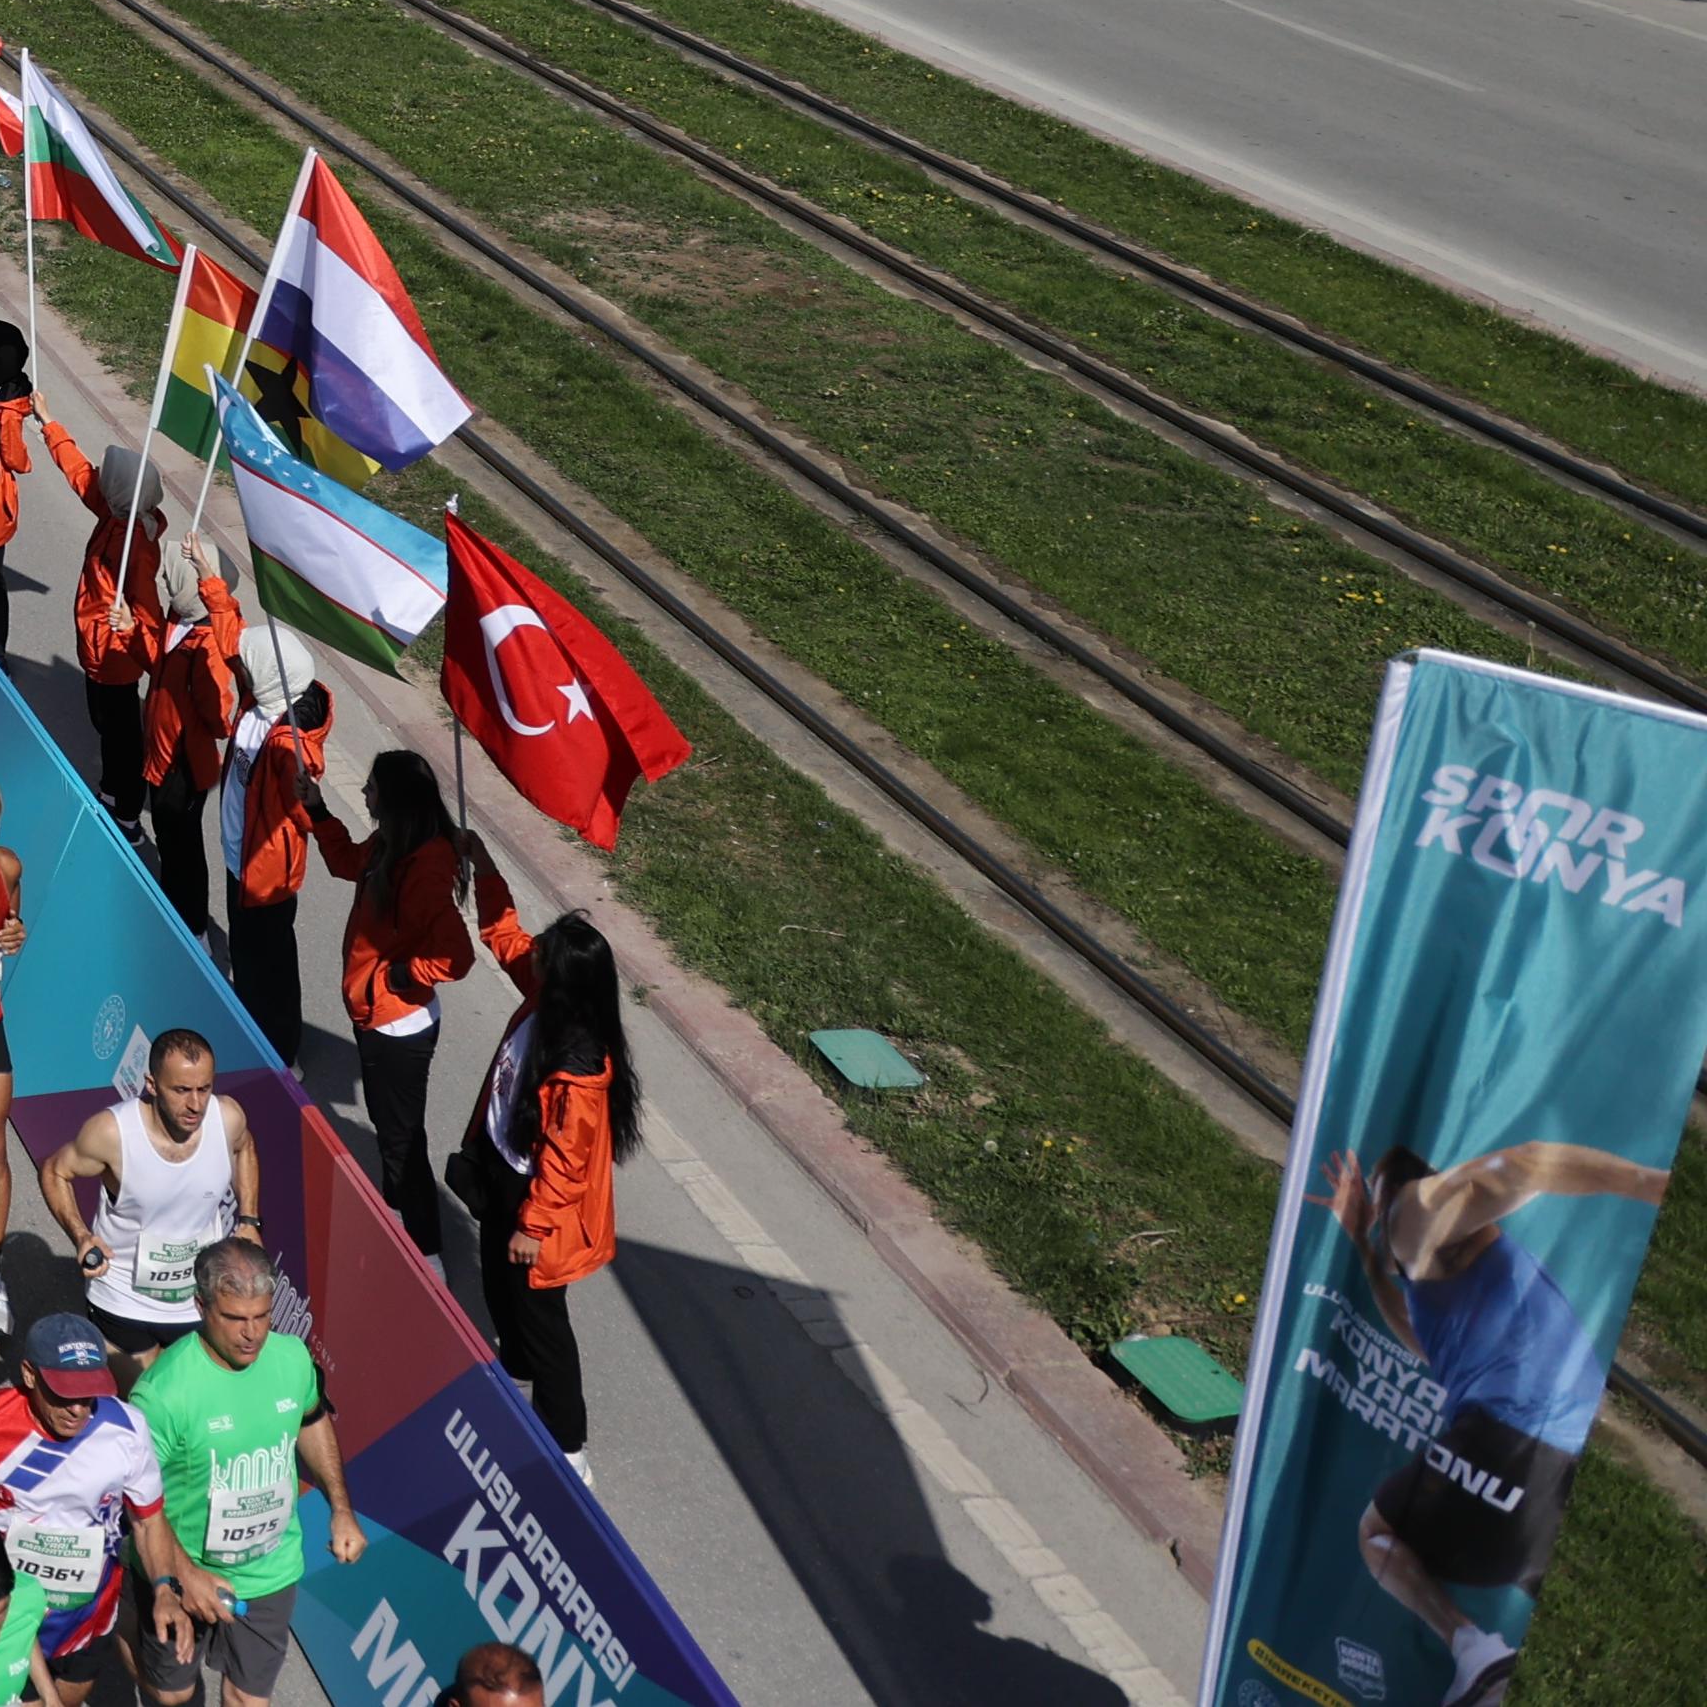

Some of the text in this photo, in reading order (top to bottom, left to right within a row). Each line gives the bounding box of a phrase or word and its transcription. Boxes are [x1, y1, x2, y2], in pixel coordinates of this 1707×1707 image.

[1420, 764, 1645, 861] SPOR
[1413, 807, 1686, 929] KONYA
[150, 1267, 194, 1282] 1059
[1330, 1311, 1449, 1414] KONYA
[1355, 1362, 1445, 1437] YARI
[1293, 1346, 1525, 1513] MARATONU
[223, 1497, 284, 1517] MARATONU
[239, 1491, 275, 1504] KONYA
[36, 1532, 78, 1545] KONYA
[223, 1518, 279, 1543] 10575
[18, 1540, 91, 1559] MARATONU
[46, 1541, 70, 1553] YARI
[444, 1406, 638, 1694] ULUSLARARASI
[17, 1558, 84, 1583] 10364
[442, 1499, 618, 1707] KONY
